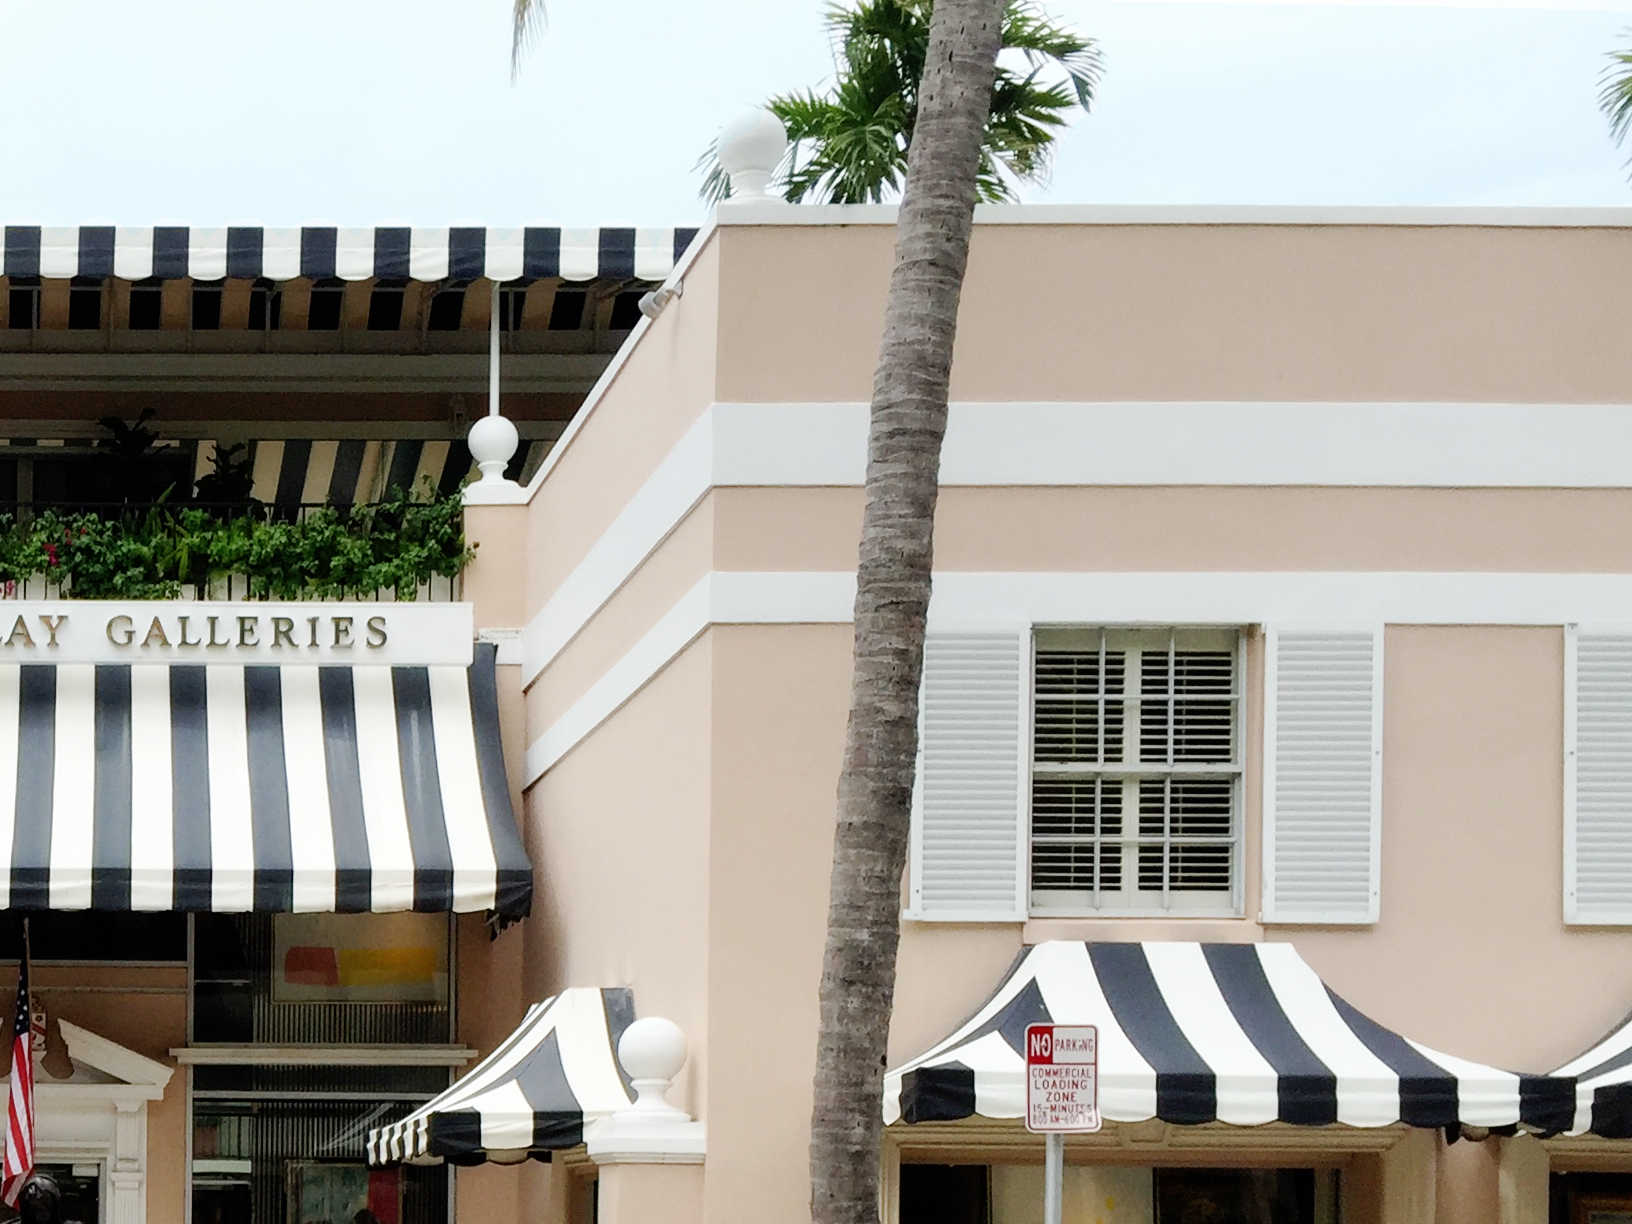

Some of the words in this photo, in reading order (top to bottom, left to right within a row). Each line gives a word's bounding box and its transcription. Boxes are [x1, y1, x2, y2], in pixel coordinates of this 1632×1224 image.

[106, 615, 388, 650] GALLERIES
[1031, 1033, 1051, 1057] NO
[1055, 1038, 1093, 1052] PARKING
[1032, 1068, 1092, 1078] COMMERCIAL
[1034, 1080, 1088, 1090] LOADING
[1046, 1091, 1077, 1102] ZONE
